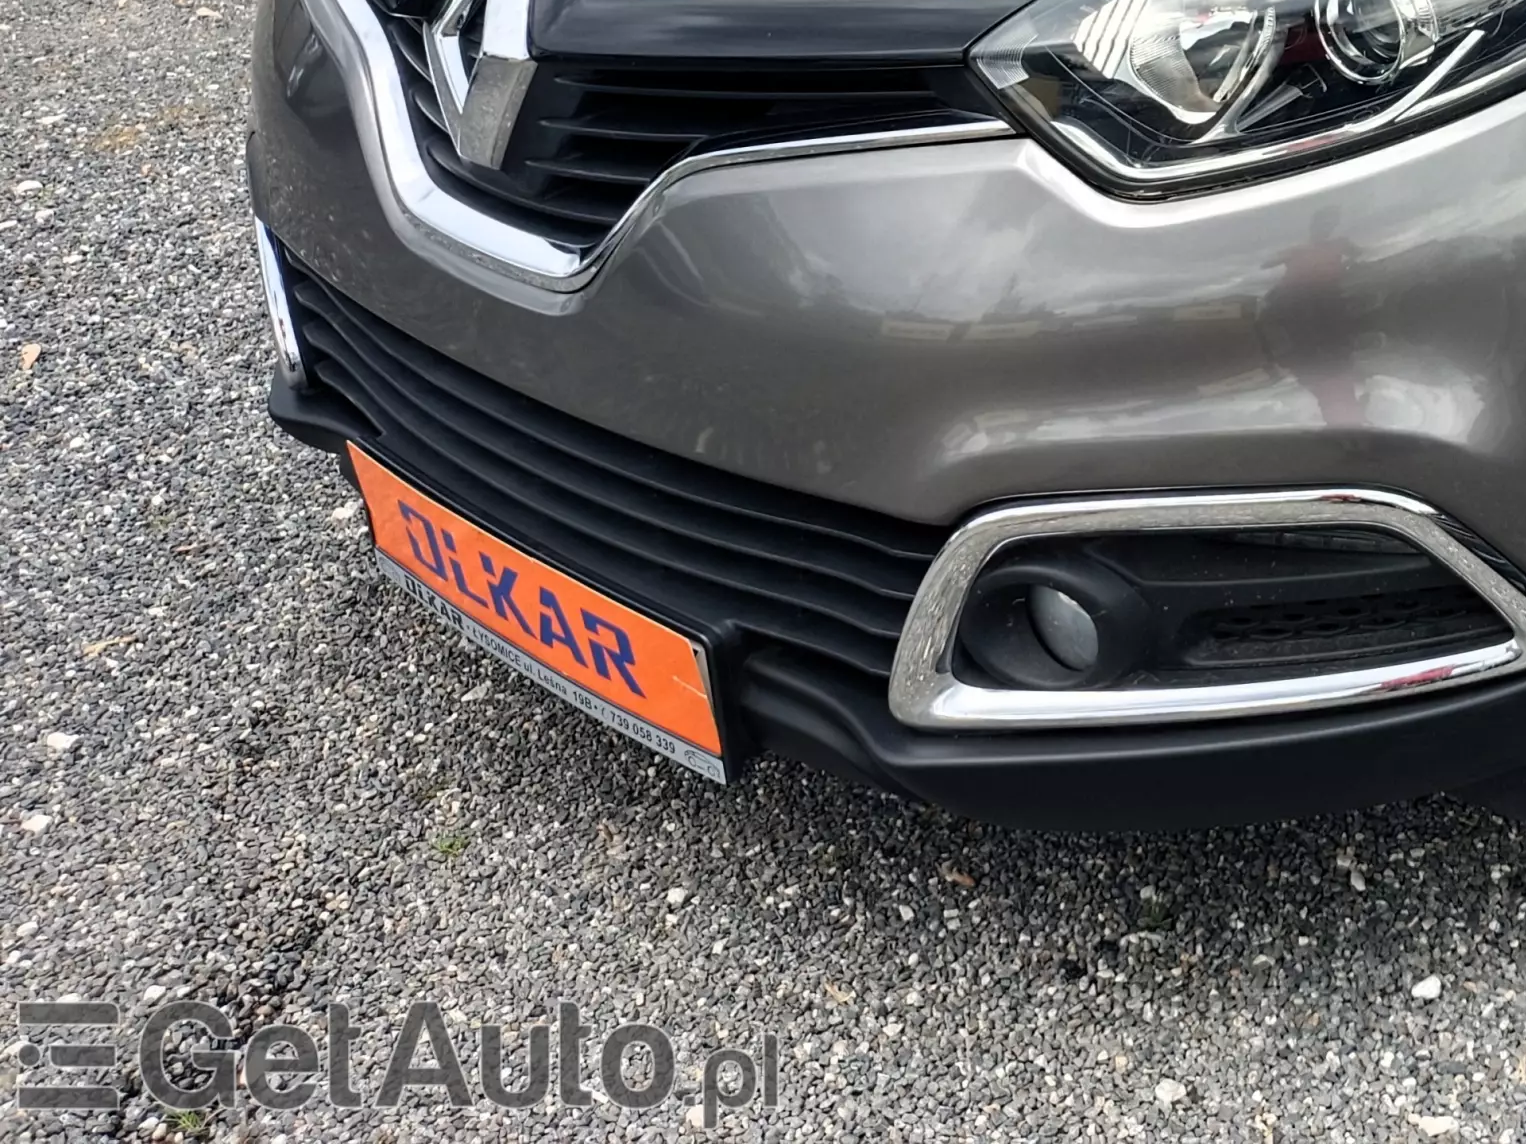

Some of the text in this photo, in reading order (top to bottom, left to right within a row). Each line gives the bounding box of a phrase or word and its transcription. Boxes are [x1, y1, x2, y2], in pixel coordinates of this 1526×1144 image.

[398, 499, 647, 699] OLKAR
[472, 627, 522, 668] ŁYSOMICE
[573, 691, 592, 710] 19B
[610, 711, 630, 730] 739
[632, 724, 652, 742] 058
[655, 735, 676, 754] 339
